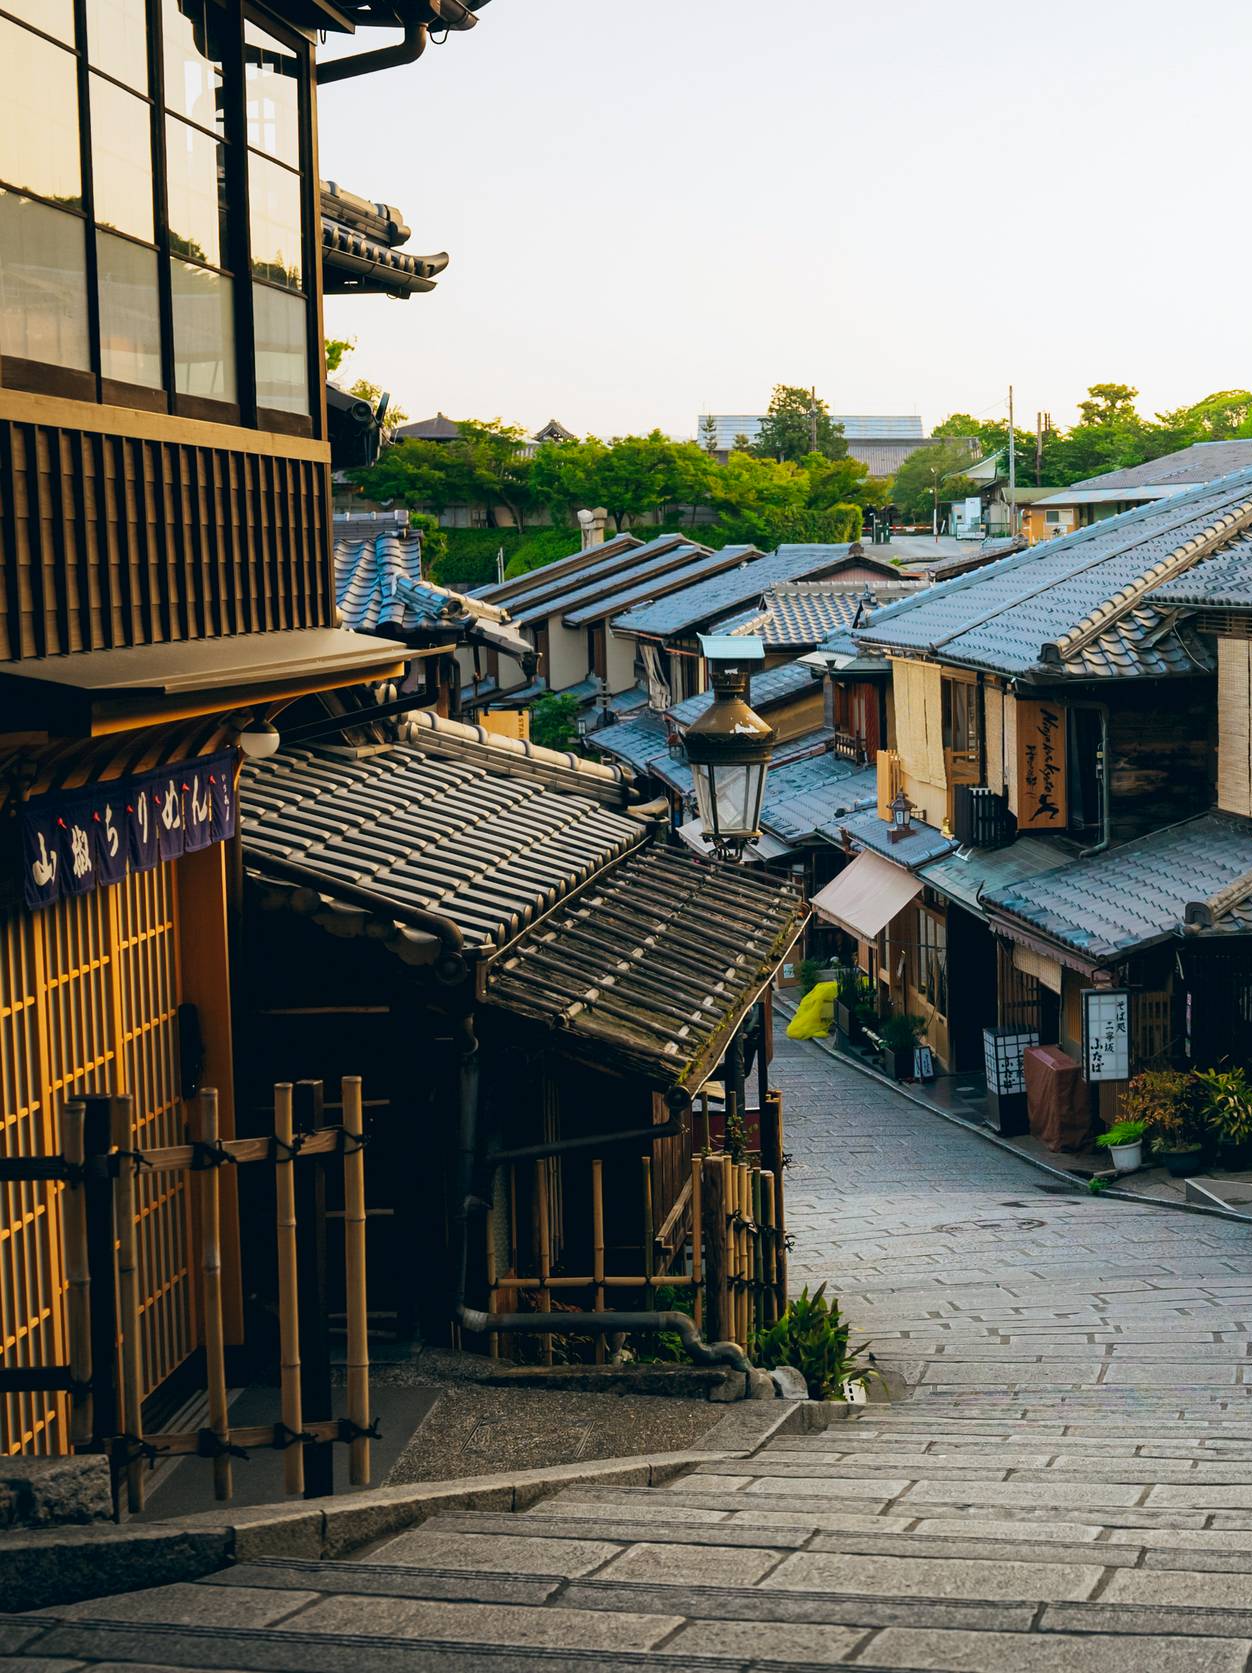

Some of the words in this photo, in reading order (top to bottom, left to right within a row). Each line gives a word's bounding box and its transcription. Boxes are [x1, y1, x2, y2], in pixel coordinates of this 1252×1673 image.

[1116, 1000, 1126, 1033] そば処
[1090, 1038, 1104, 1073] ふたば
